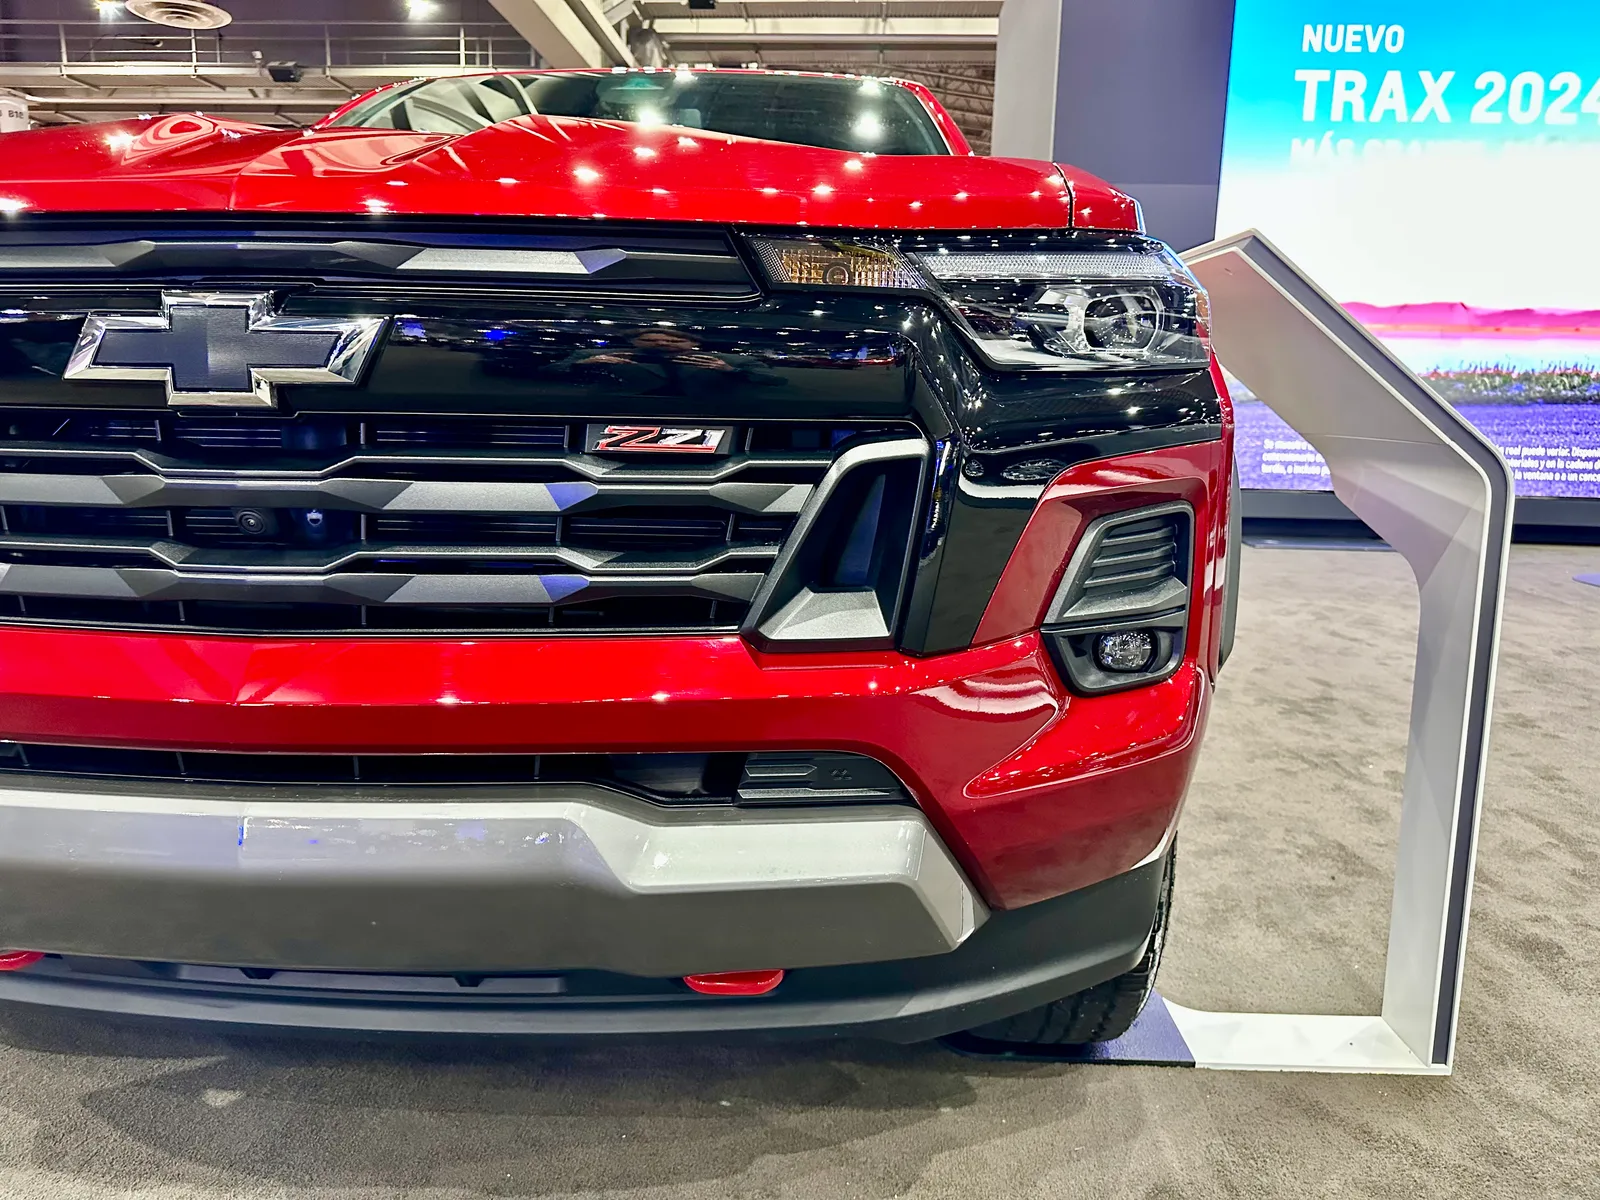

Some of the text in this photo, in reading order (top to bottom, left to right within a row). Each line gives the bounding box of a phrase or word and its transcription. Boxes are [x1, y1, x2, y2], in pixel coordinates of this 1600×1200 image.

[1302, 24, 1405, 53] NUEVO
[1295, 69, 1455, 122] TRAX
[592, 425, 726, 453] Z71
